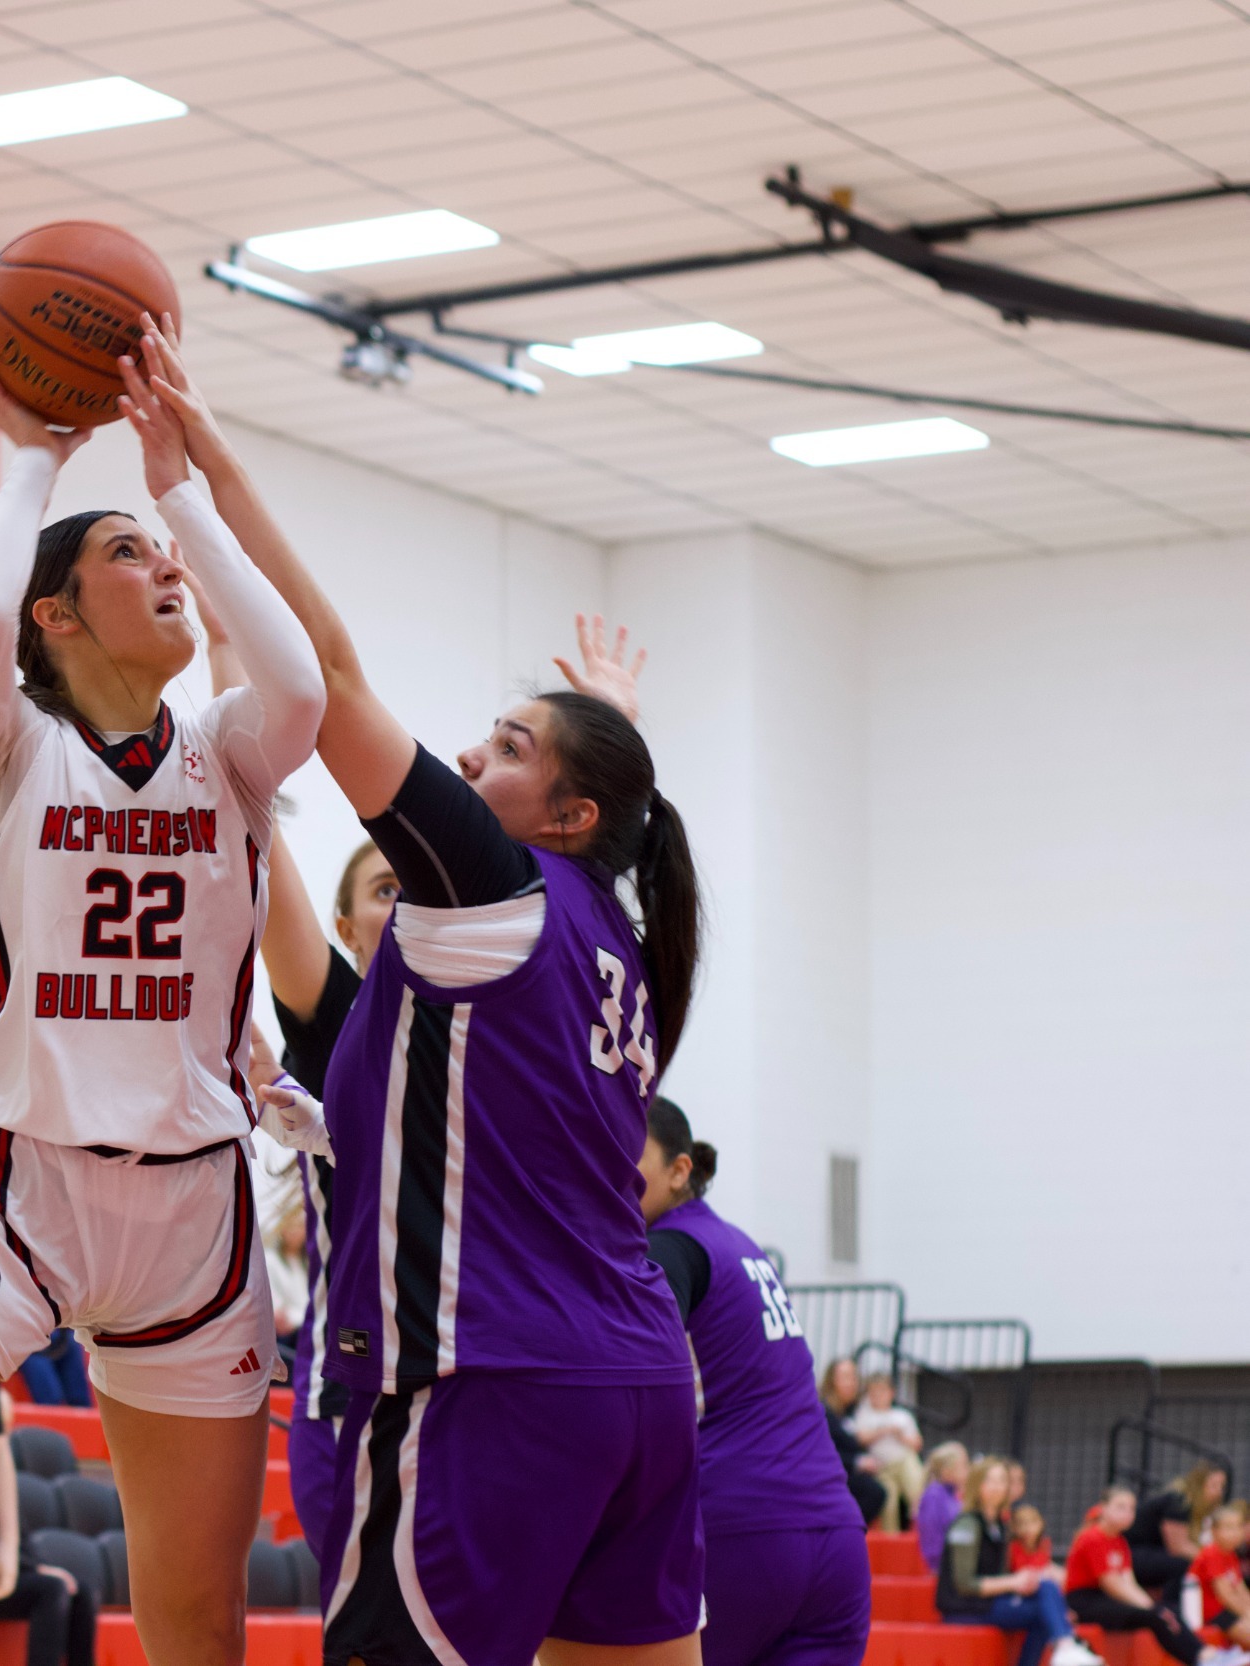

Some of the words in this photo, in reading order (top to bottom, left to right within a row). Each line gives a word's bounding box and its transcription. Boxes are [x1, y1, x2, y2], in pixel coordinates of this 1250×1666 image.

[81, 867, 186, 960] 22
[590, 946, 656, 1098] 34
[741, 1257, 804, 1342] 32
